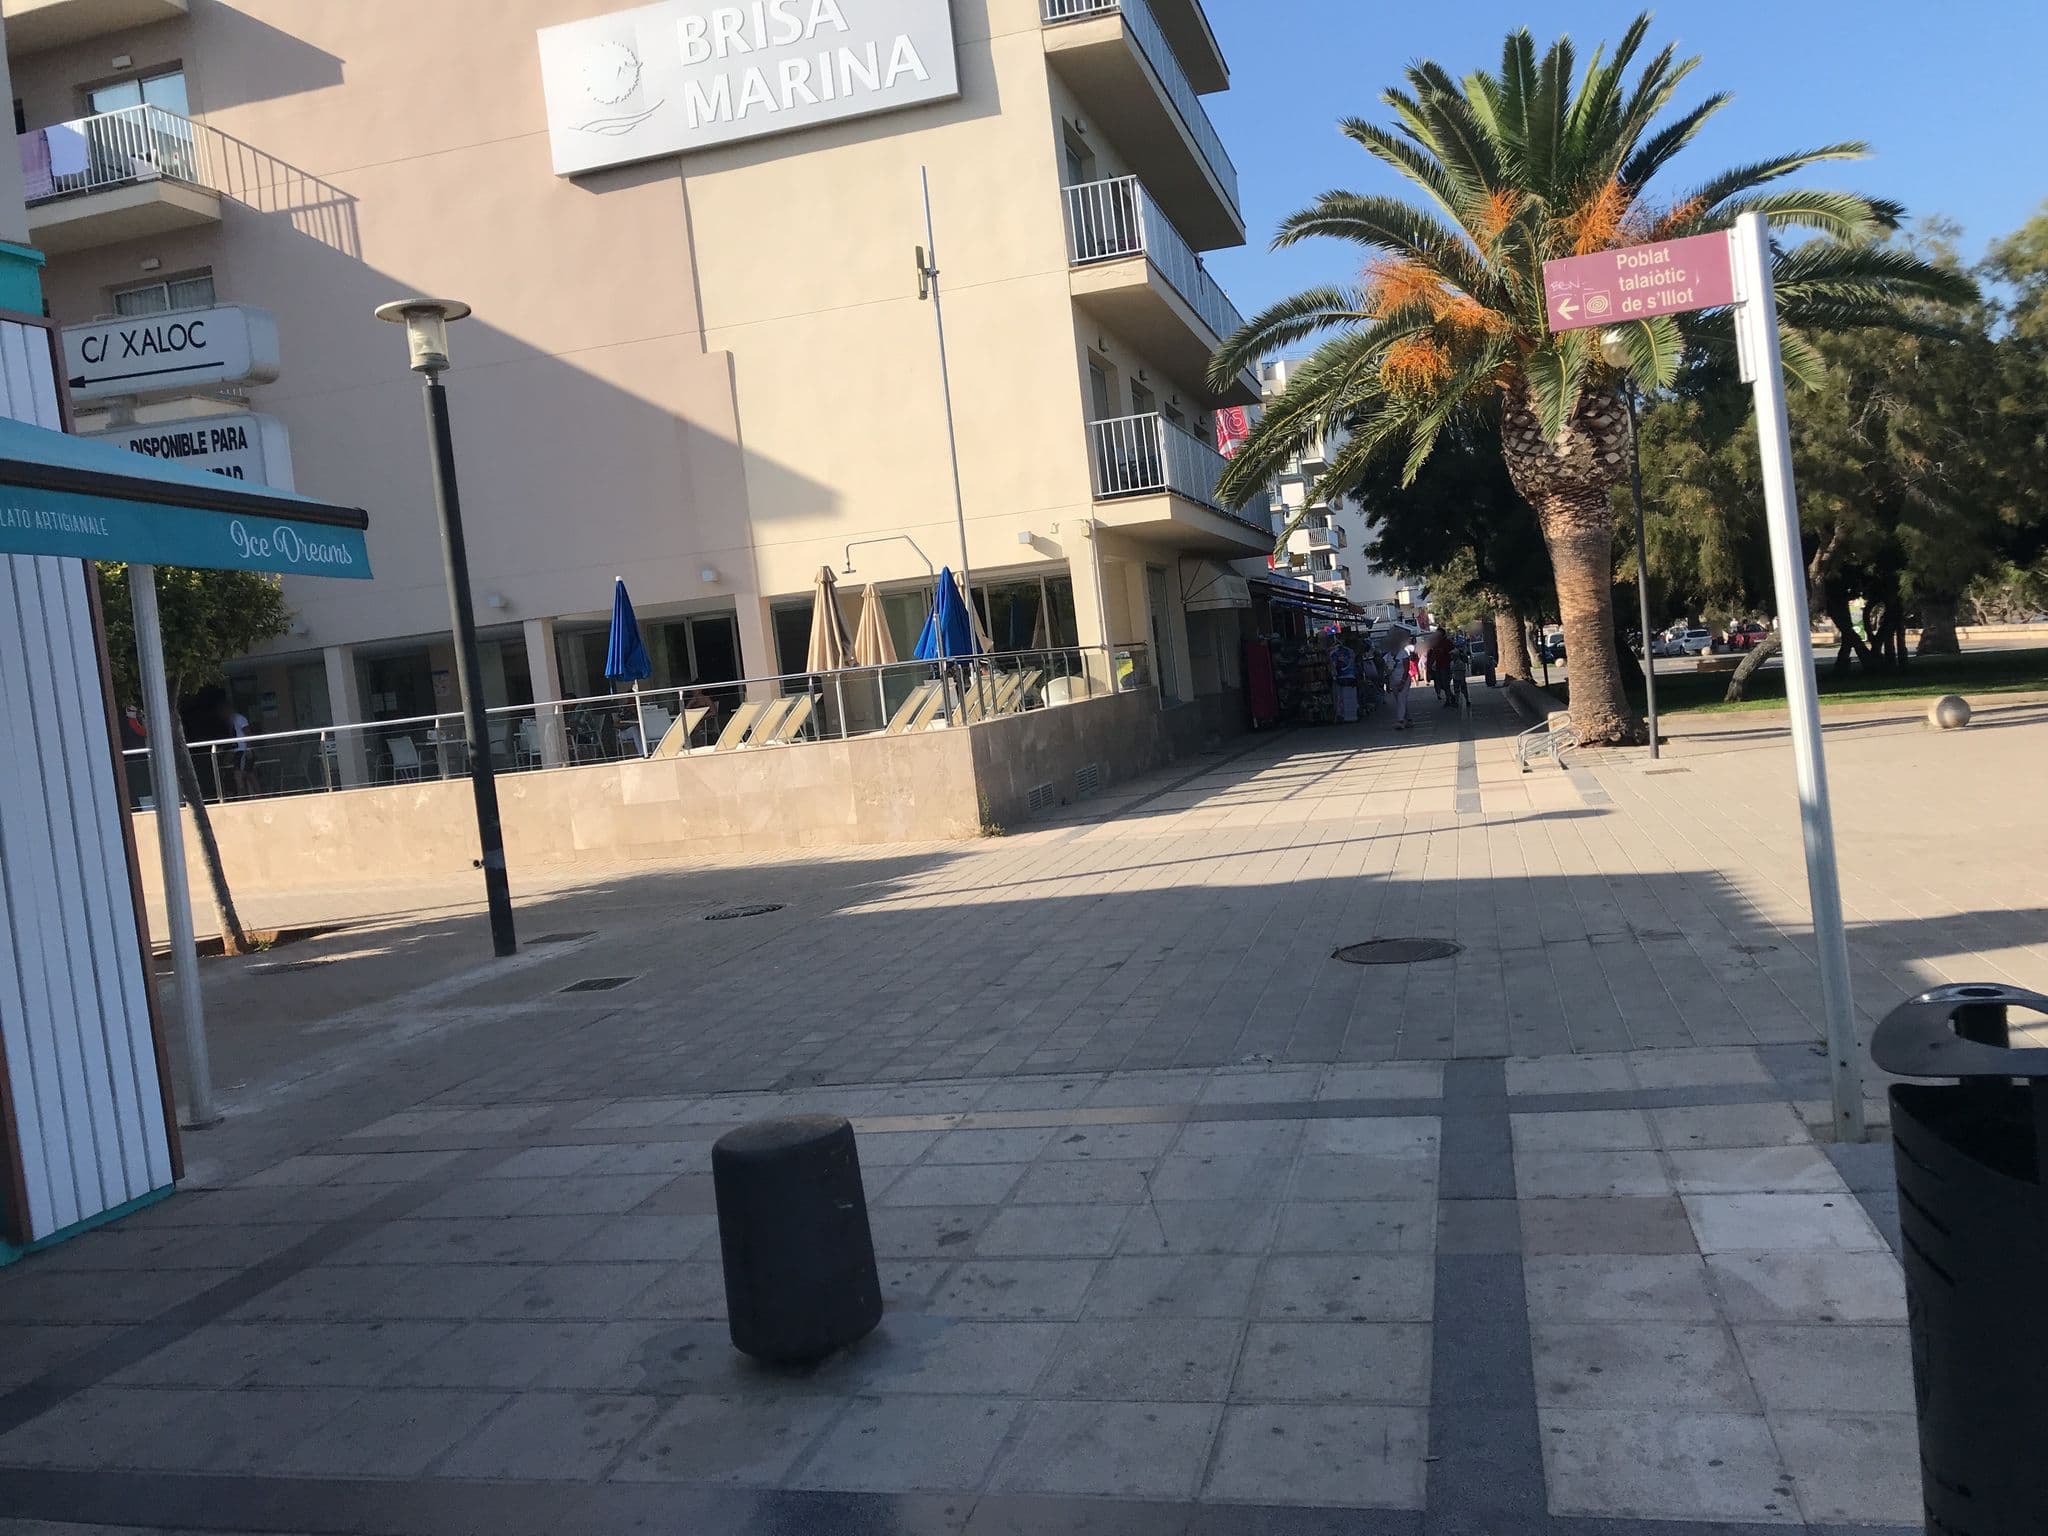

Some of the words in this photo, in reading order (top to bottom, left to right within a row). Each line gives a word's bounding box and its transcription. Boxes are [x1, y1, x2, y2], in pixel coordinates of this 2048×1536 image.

[677, 0, 849, 65] BRISA
[685, 34, 929, 129] MARINA
[1616, 248, 1670, 270] Poblat
[1619, 268, 1686, 292] talaiòtic
[1621, 296, 1642, 313] de
[81, 332, 109, 364] C/
[120, 321, 206, 358] XALOC
[210, 425, 248, 453] PARA
[35, 511, 109, 536] ARTIGIANALE
[230, 520, 272, 558] Ice
[273, 526, 353, 564] Dreams
